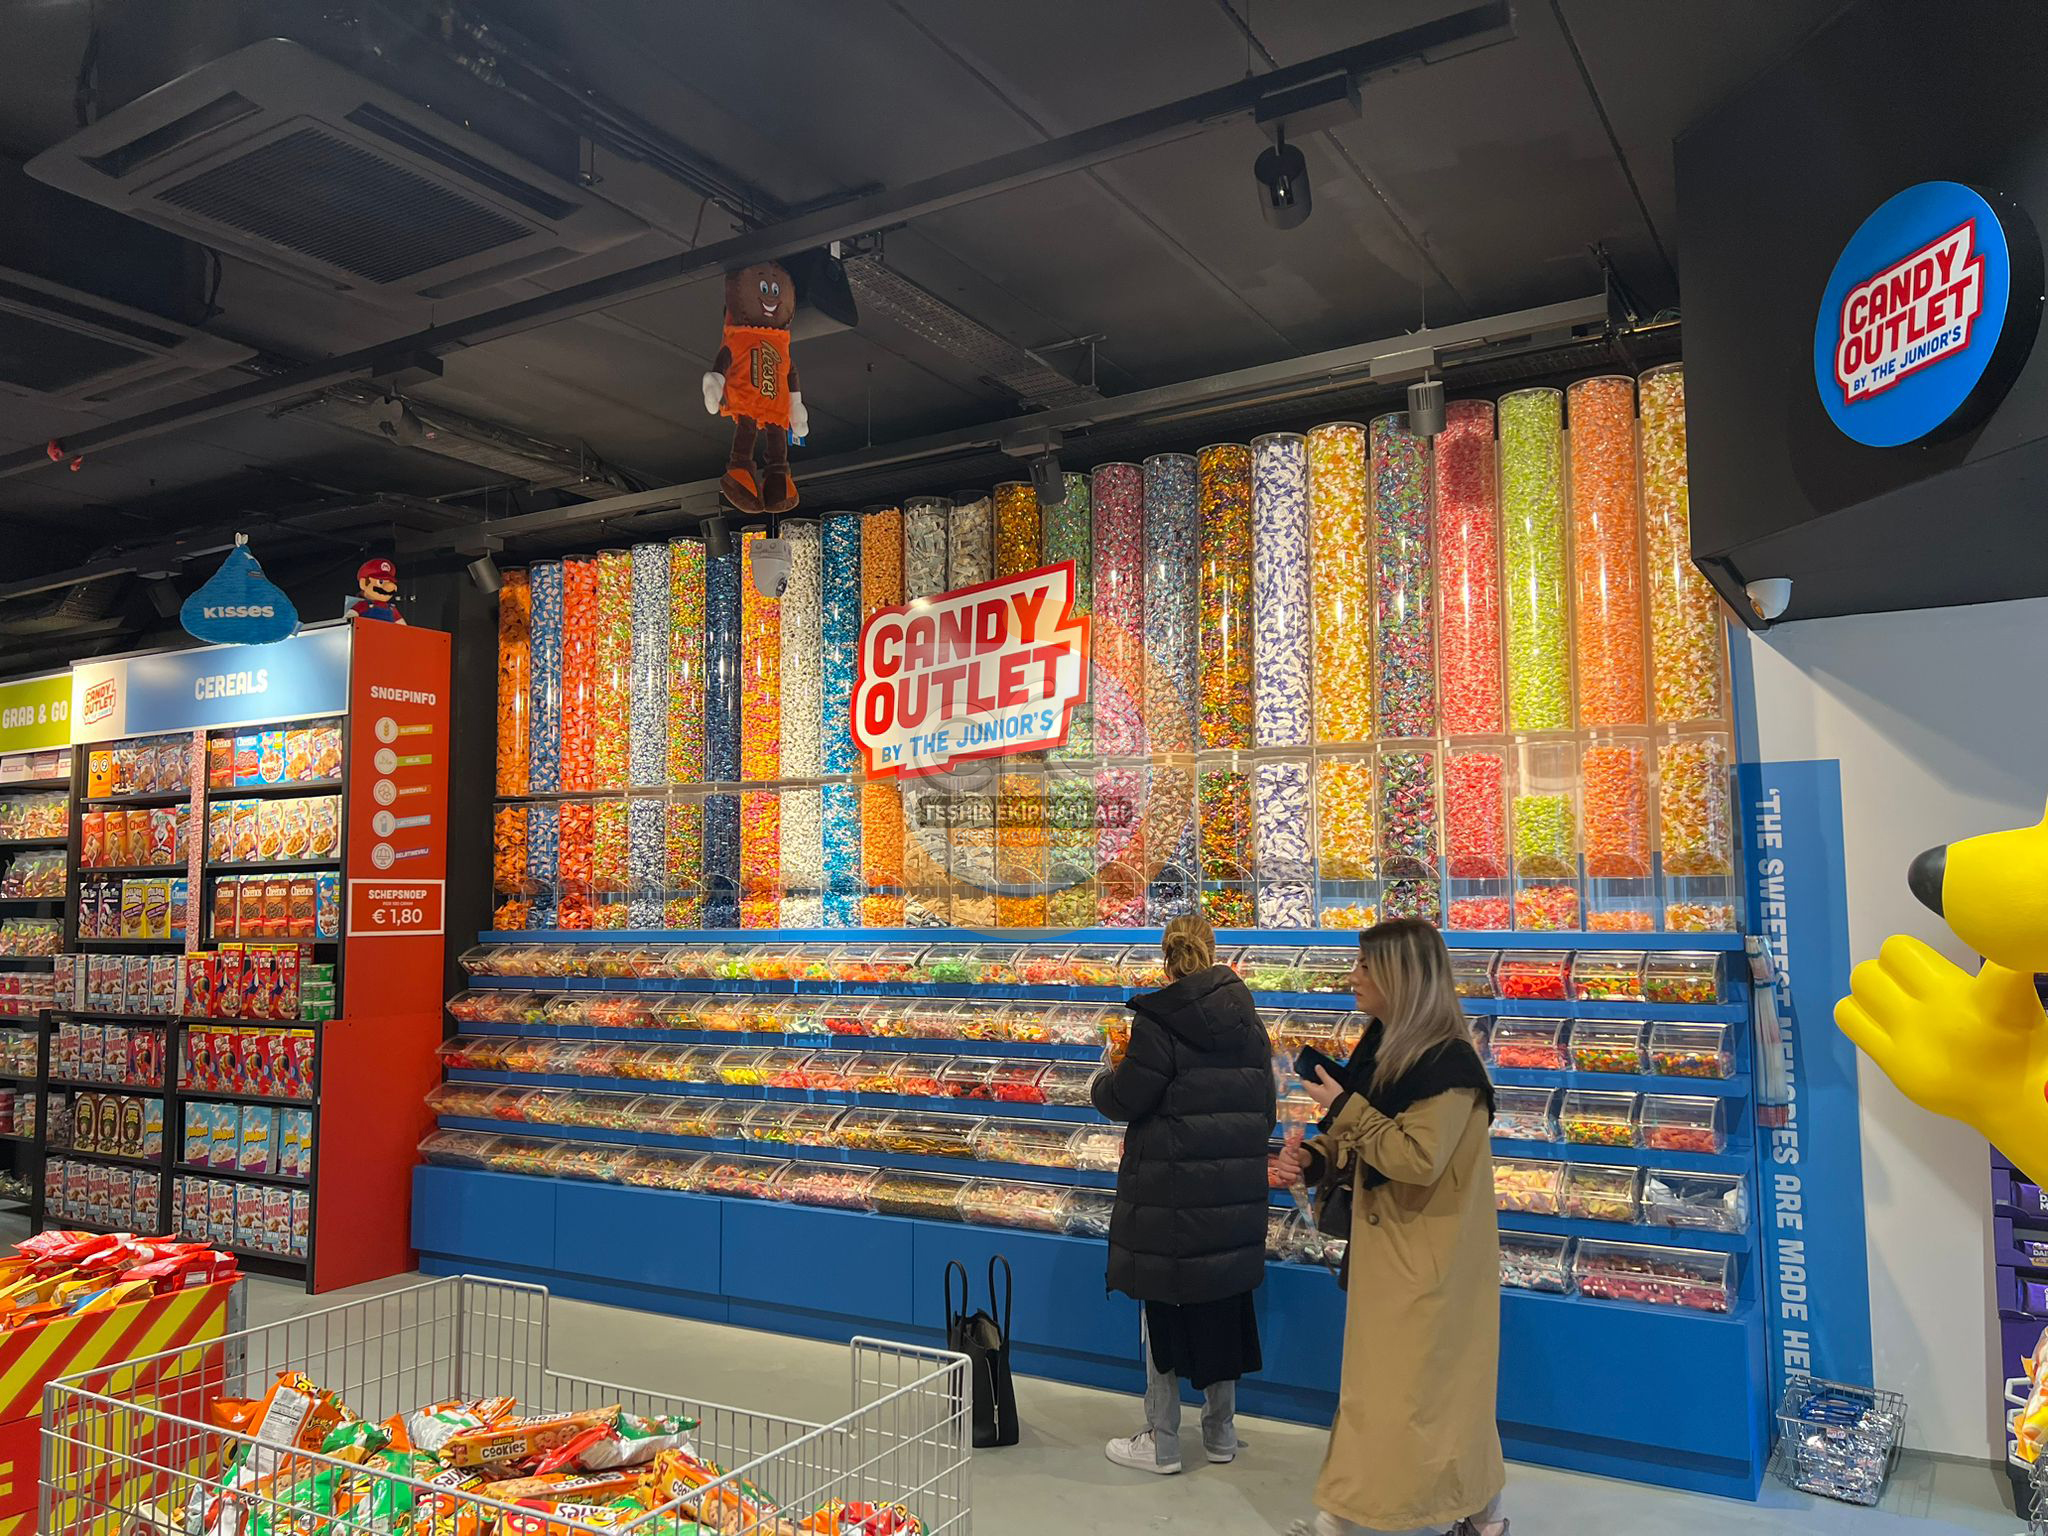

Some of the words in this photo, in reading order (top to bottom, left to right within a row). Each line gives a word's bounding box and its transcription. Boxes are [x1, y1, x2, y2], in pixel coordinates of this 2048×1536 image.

[1849, 241, 1959, 335] CANDY
[1843, 275, 1973, 375] OUTLET
[1854, 374, 1867, 392] BY
[1871, 359, 1895, 383] THE
[1901, 326, 1962, 368] JUNIOR'S
[872, 585, 1049, 679] CANDY
[84, 695, 113, 715] OUTLET
[195, 668, 268, 701] CEREALS
[370, 685, 437, 706] SNOEPINFO
[865, 642, 1071, 735] OUTLET
[2, 705, 34, 729] GRAB
[38, 703, 48, 725] &
[51, 699, 69, 723] GO
[882, 743, 903, 764] BY
[910, 729, 949, 757] THE
[956, 709, 1054, 745] JUNIOR'S
[129, 820, 146, 831] Chex
[368, 889, 428, 900] SCHEPSNOEP
[372, 908, 386, 924] €
[390, 908, 423, 927] 1,80
[1774, 1173, 1804, 1231] ARE
[1778, 1237, 1809, 1322] MADE
